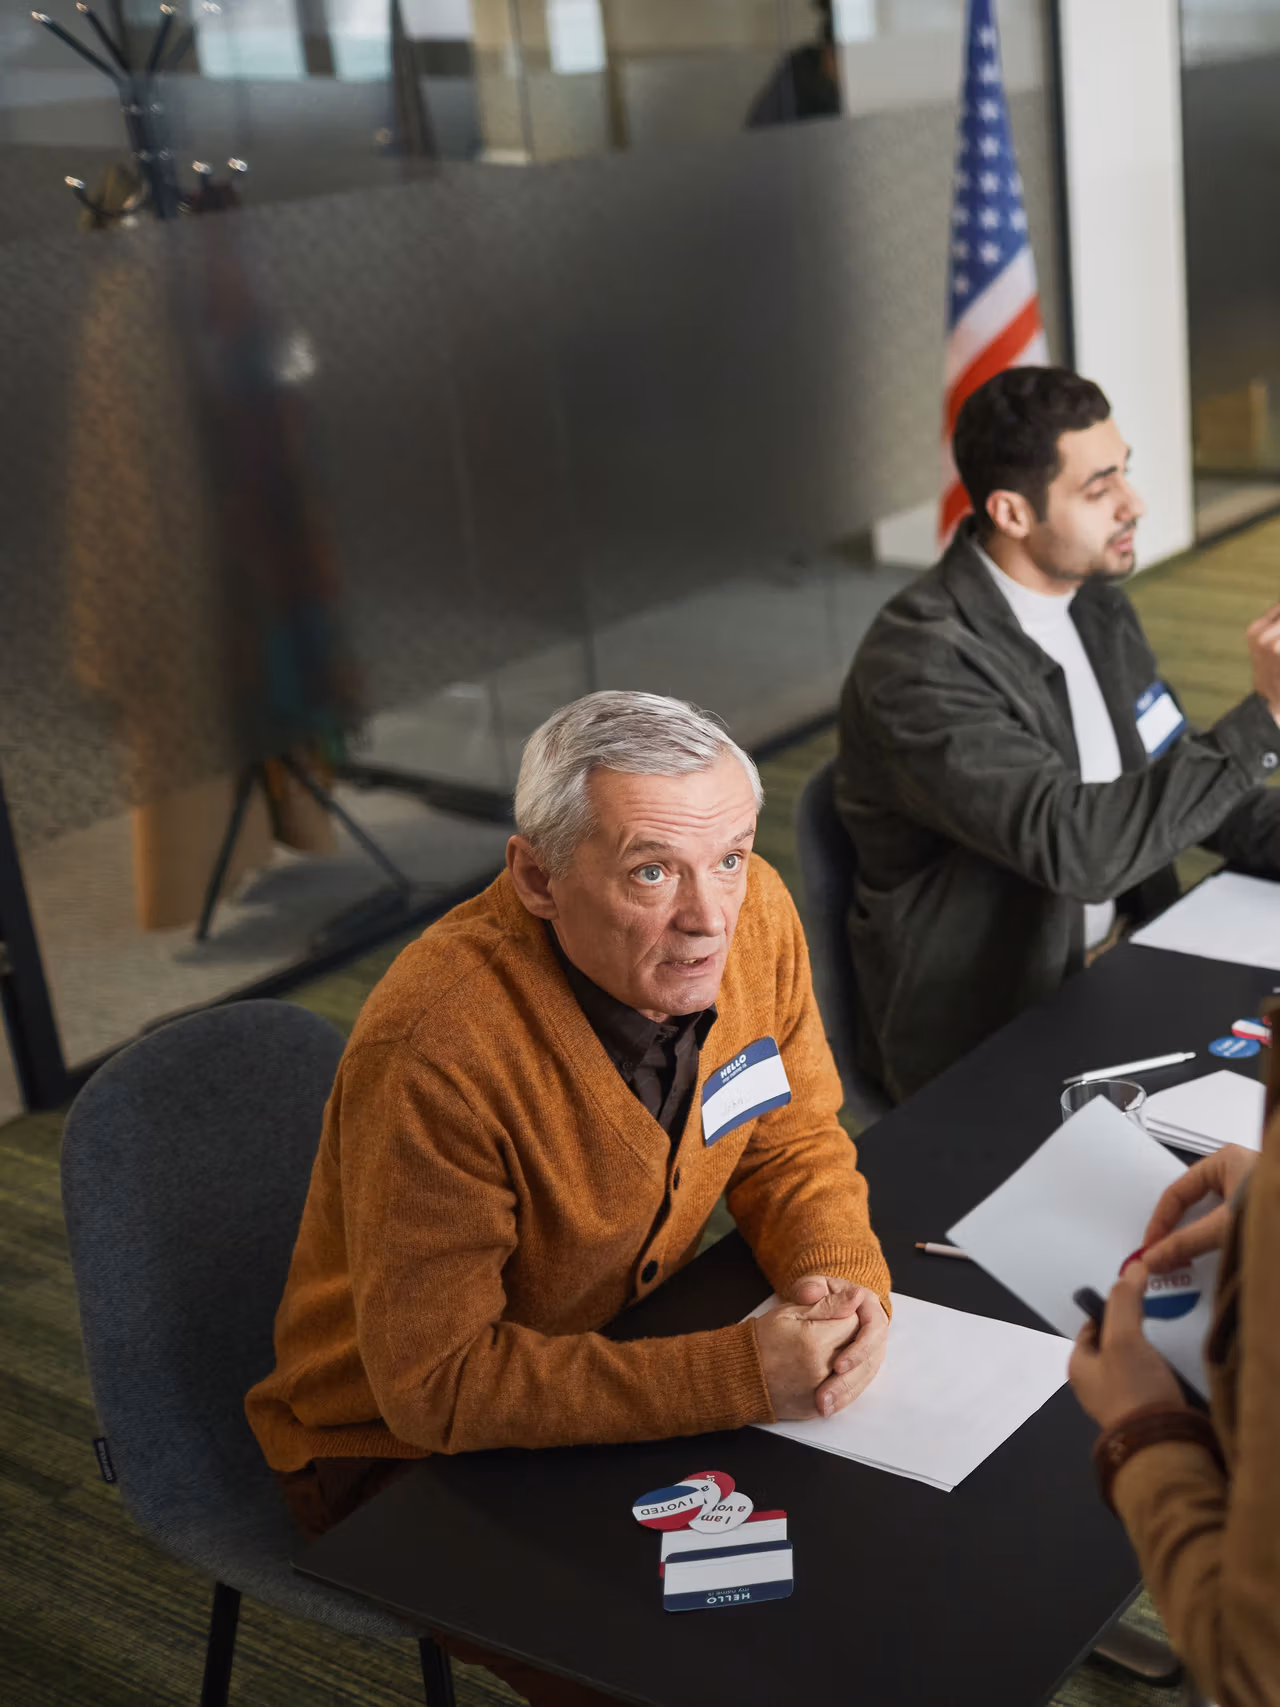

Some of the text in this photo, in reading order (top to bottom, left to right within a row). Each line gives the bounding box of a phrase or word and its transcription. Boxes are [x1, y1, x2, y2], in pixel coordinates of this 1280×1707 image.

[720, 1054, 747, 1078] HELLO
[640, 1497, 695, 1516] I VOTED
[711, 1504, 747, 1514] a vot
[700, 1514, 732, 1525] I am
[706, 1592, 751, 1605] HELLO
